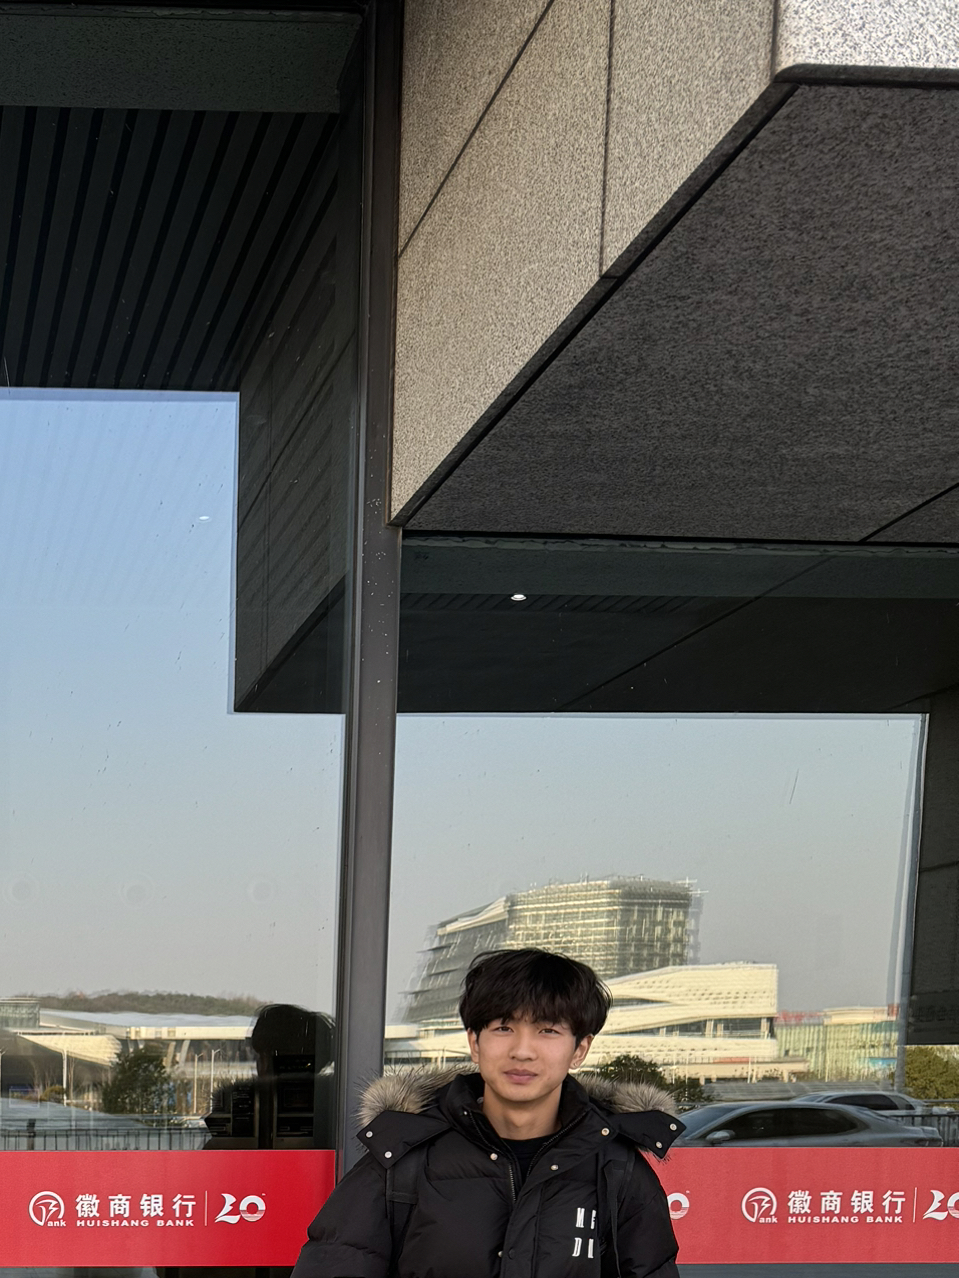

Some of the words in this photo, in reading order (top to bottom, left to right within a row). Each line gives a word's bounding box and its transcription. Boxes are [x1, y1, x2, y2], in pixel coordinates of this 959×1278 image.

[75, 1194, 196, 1218] 徽商银行
[666, 1192, 690, 1220] 0
[788, 1190, 905, 1214] 徽商银行
[76, 1219, 150, 1227] HUISHANG
[157, 1219, 195, 1227] BANK
